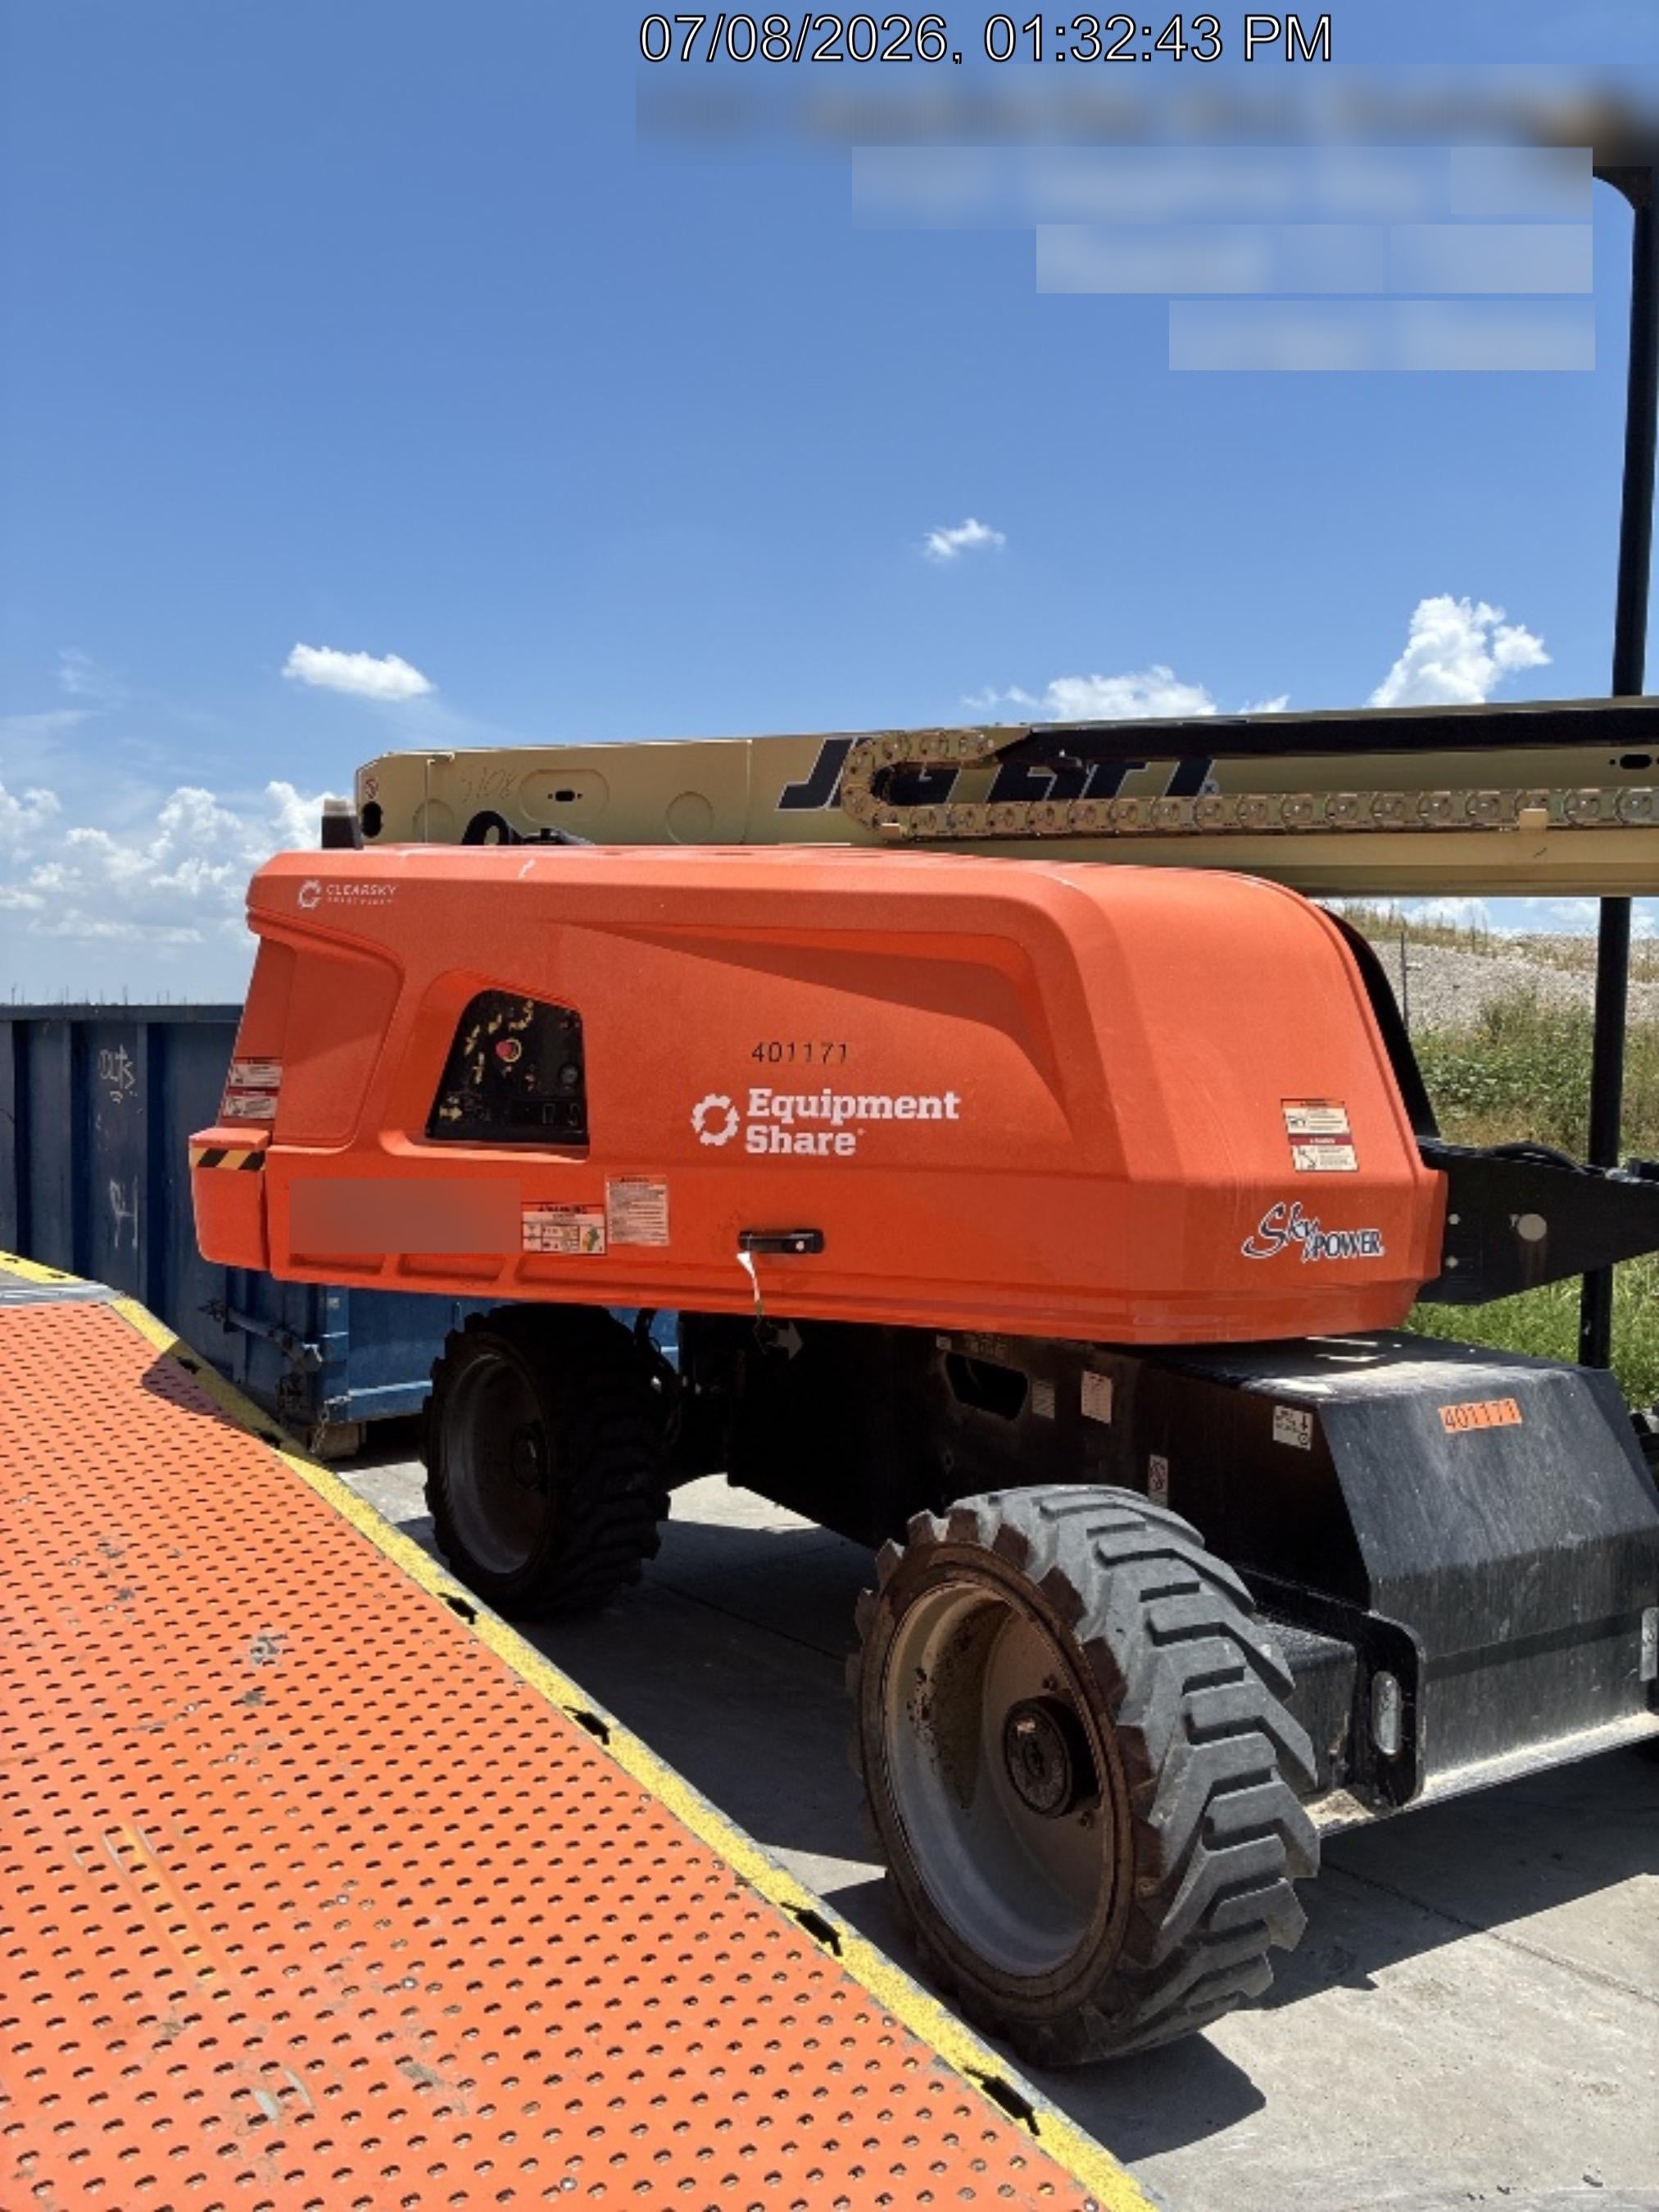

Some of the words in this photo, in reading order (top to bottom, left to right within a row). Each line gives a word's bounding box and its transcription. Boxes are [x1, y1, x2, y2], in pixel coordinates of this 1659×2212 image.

[326, 884, 397, 895] CLEARSKY
[750, 1041, 847, 1063] 401171
[746, 1088, 961, 1126] Equipment
[746, 1125, 857, 1156] Share
[1241, 1201, 1320, 1264] Sky
[1312, 1228, 1383, 1261] POWER
[1444, 1398, 1517, 1430] 401171
